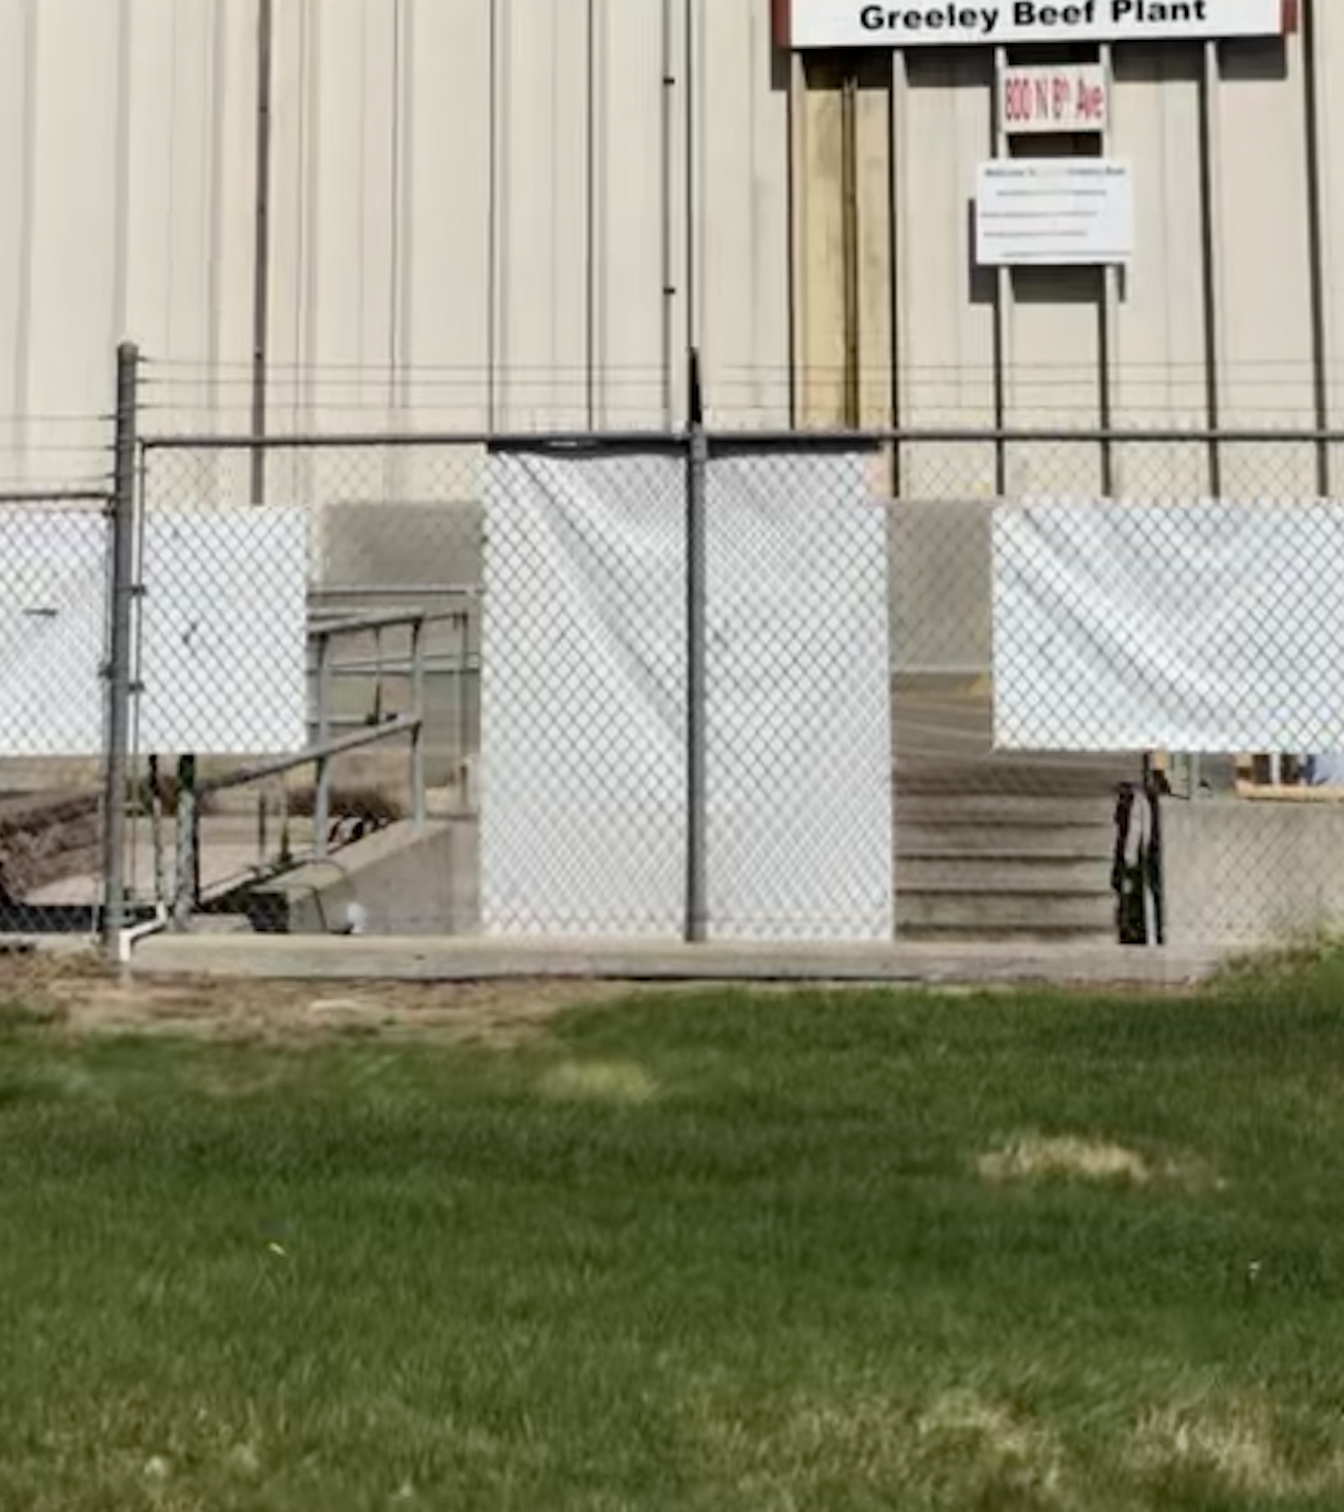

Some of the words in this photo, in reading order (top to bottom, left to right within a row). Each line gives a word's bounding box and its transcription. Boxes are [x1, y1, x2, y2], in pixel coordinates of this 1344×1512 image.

[860, 2, 999, 34] Greeley
[1013, 0, 1096, 27] Beef
[1034, 76, 1050, 120] N
